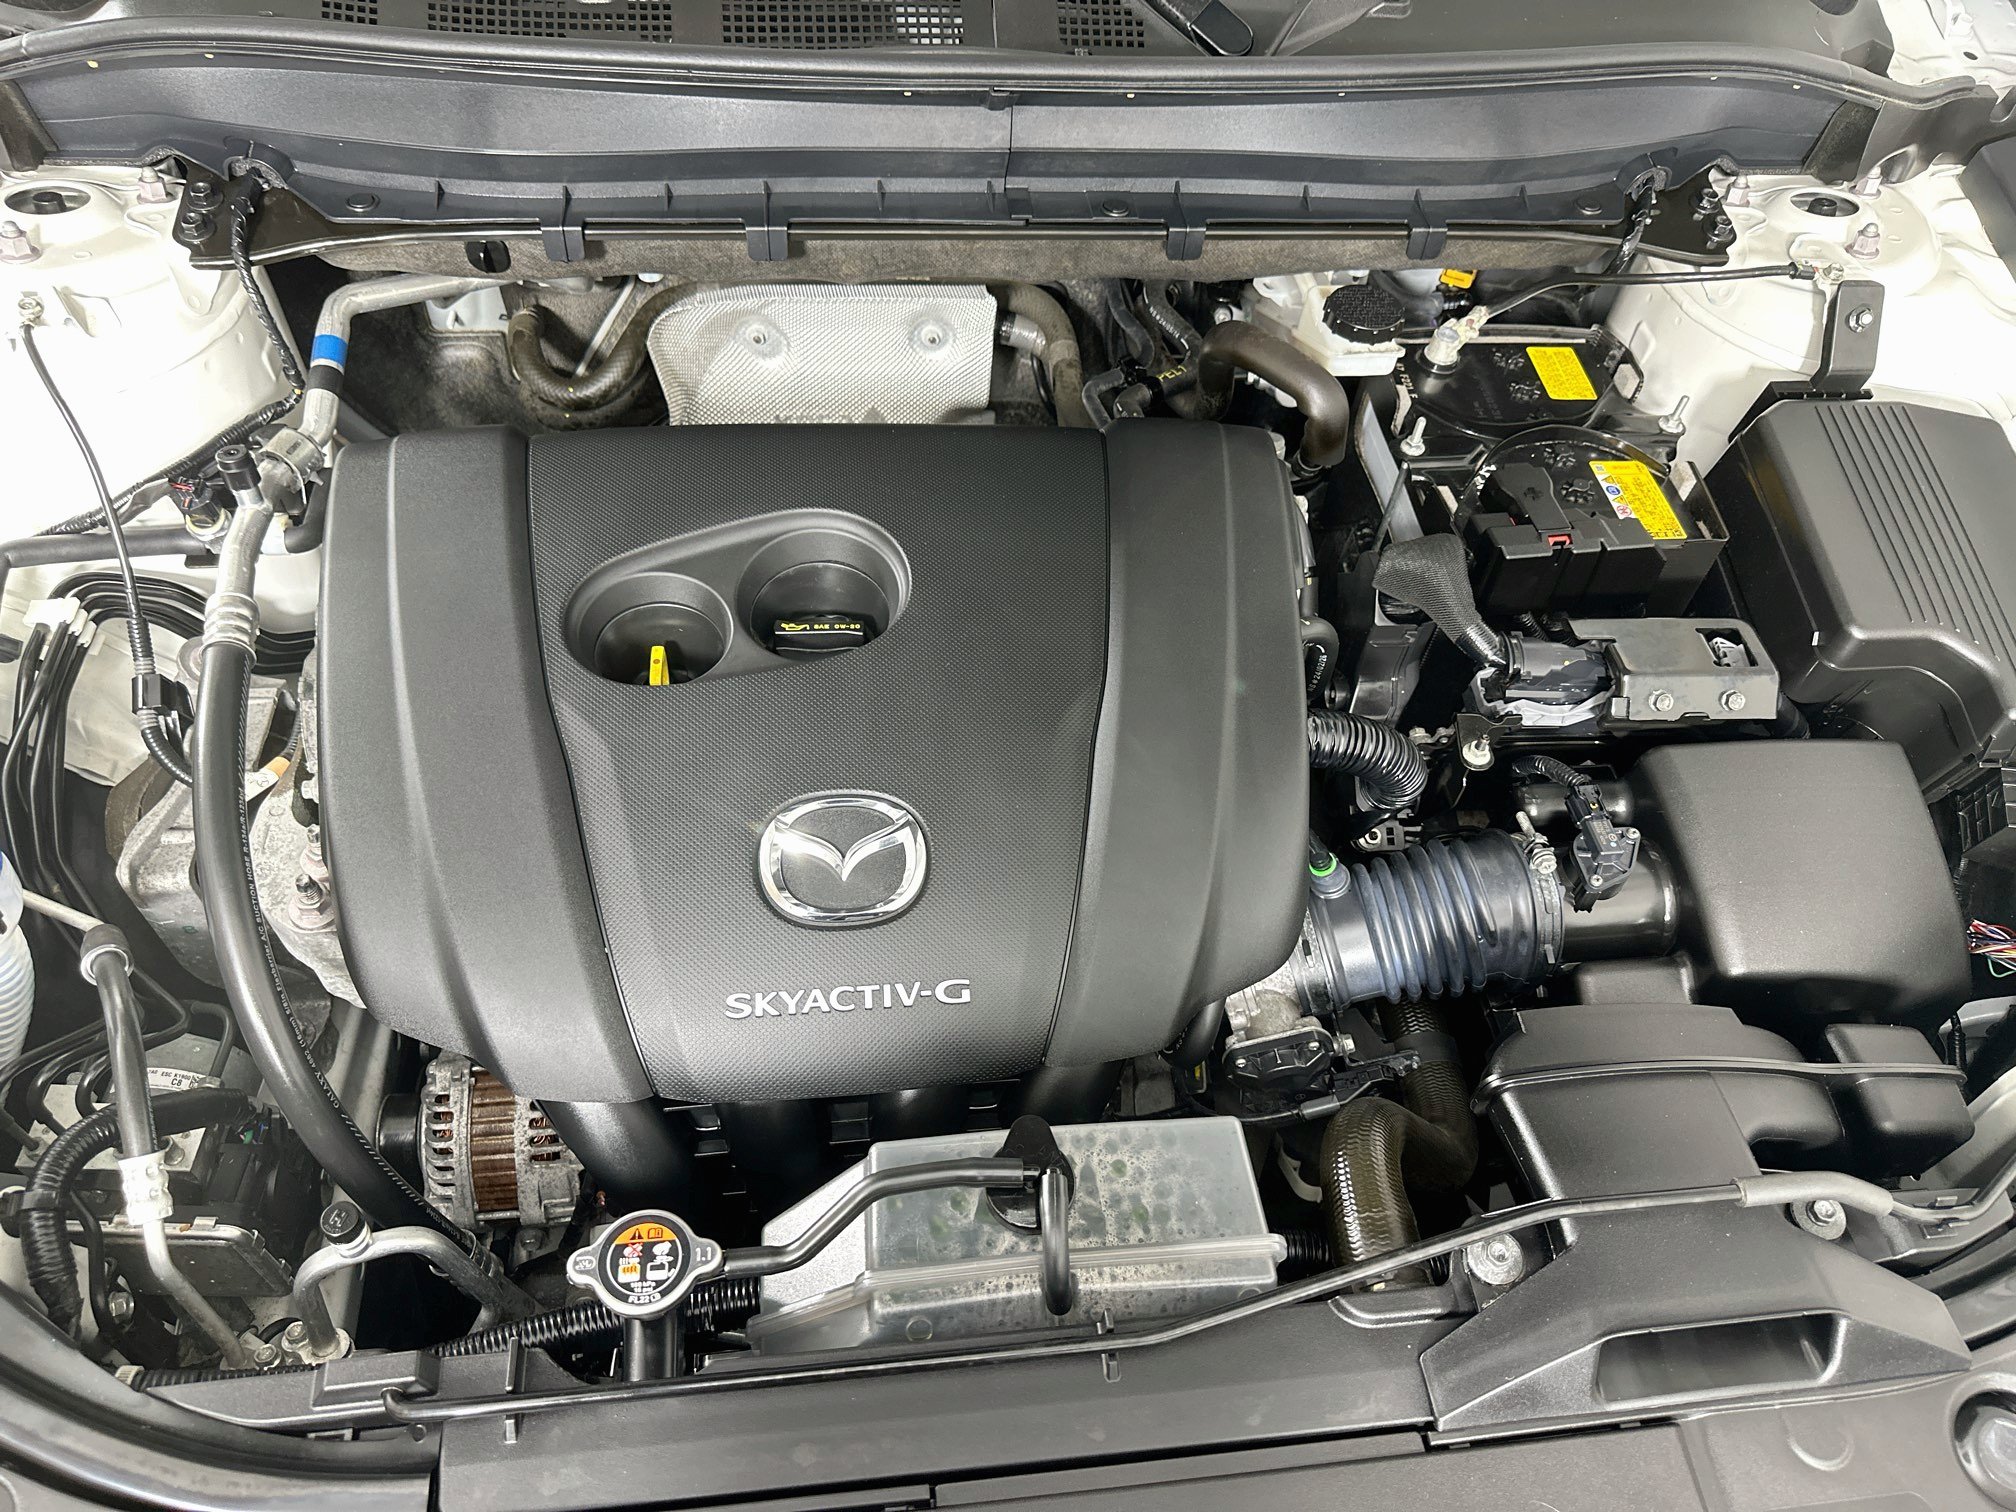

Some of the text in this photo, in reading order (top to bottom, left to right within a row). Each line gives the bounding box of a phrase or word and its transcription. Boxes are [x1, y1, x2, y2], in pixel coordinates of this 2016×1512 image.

[244, 856, 255, 881] HOSE
[248, 884, 262, 923] SUCTION
[258, 926, 267, 941] A/C
[264, 944, 283, 992] Flexbarrier
[723, 978, 972, 1019] SKYACTIV-G
[289, 1016, 306, 1048] (16mm)
[314, 1070, 340, 1109] GALAXY
[695, 1247, 712, 1261] 1.1
[628, 1295, 650, 1304] FL22
